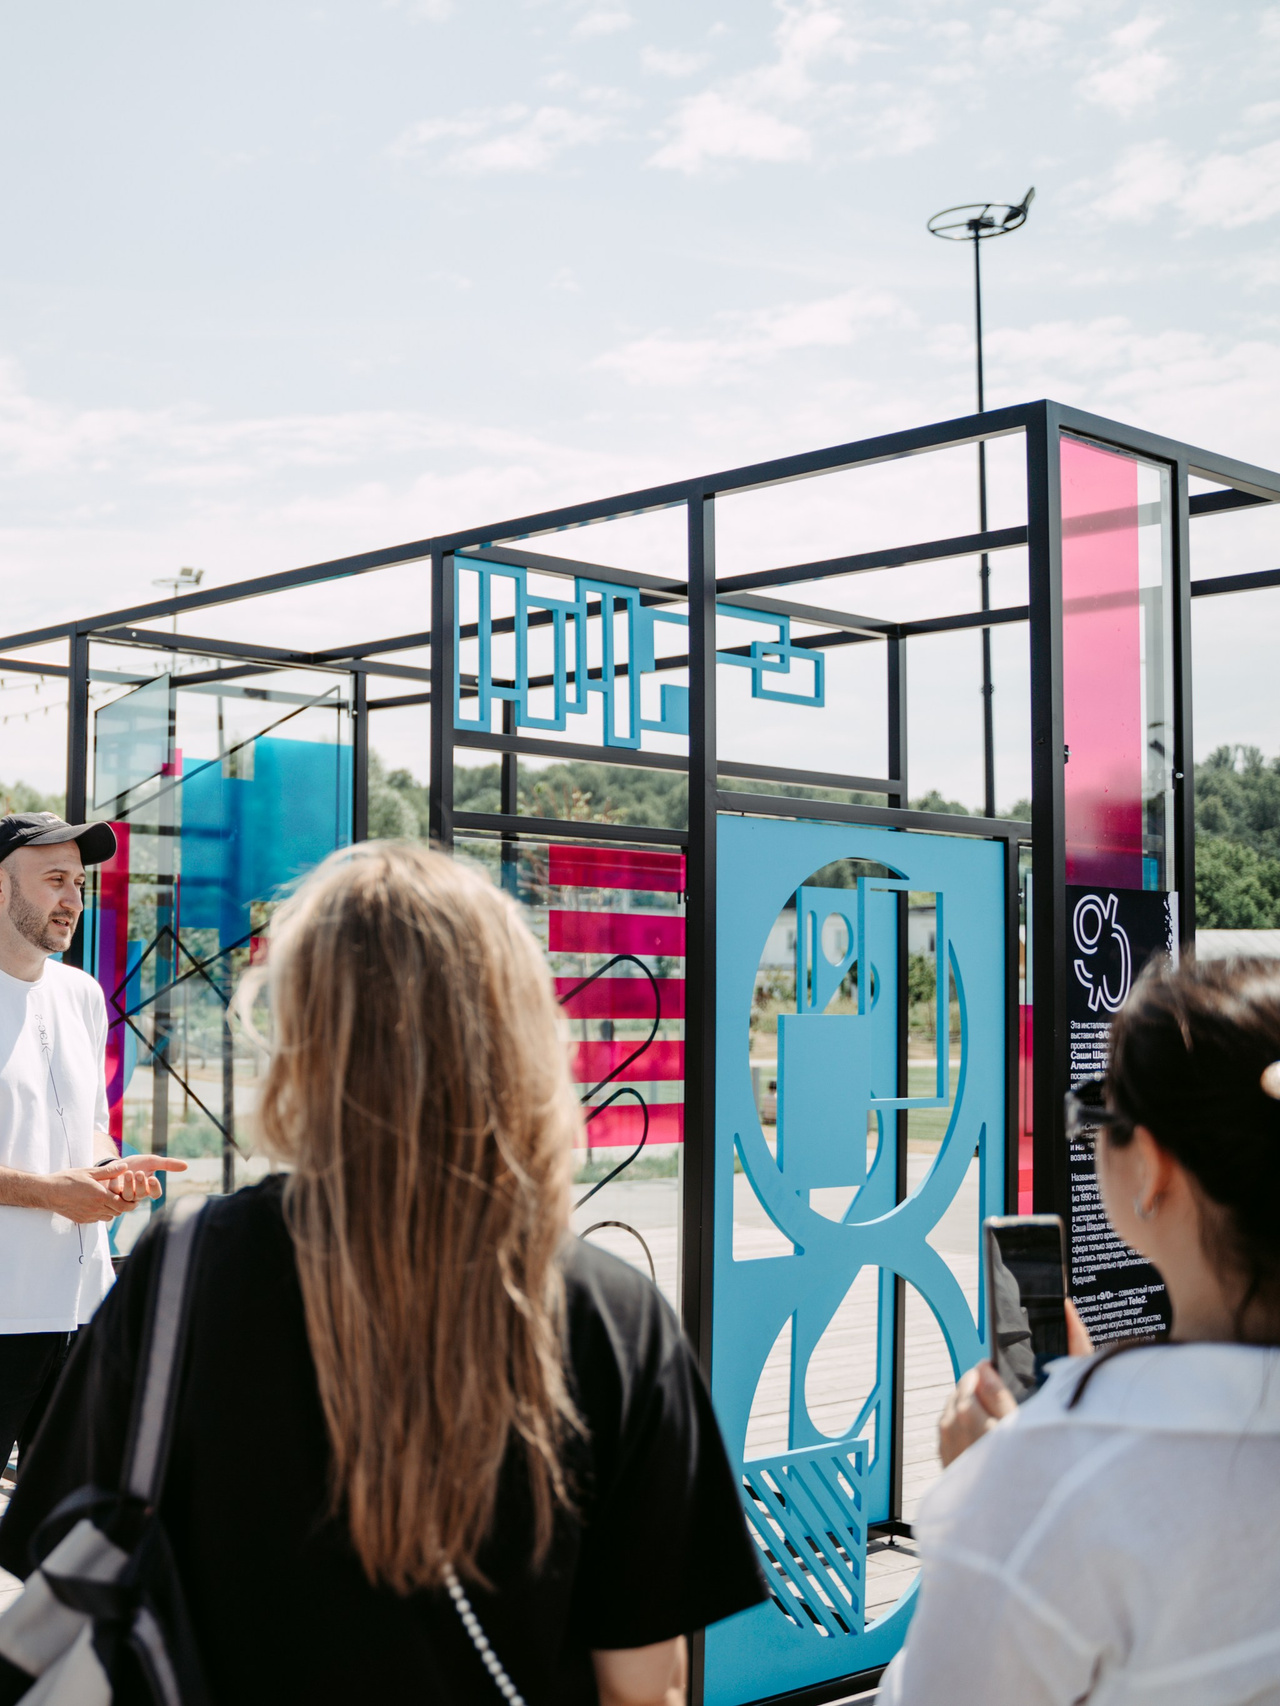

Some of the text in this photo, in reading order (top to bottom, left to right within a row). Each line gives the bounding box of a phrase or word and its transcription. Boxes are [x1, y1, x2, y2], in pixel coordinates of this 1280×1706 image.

[1070, 1020, 1080, 1029] Эта
[1070, 1042, 1091, 1051] проекта
[1070, 1051, 1091, 1060] Саши
[1070, 1060, 1101, 1070] Алексея
[1071, 1173, 1096, 1182] Название
[1072, 1224, 1086, 1233] Саша
[1072, 1245, 1088, 1255] сфера
[1148, 1284, 1165, 1293] проект
[1128, 1295, 1148, 1305] Tele2.
